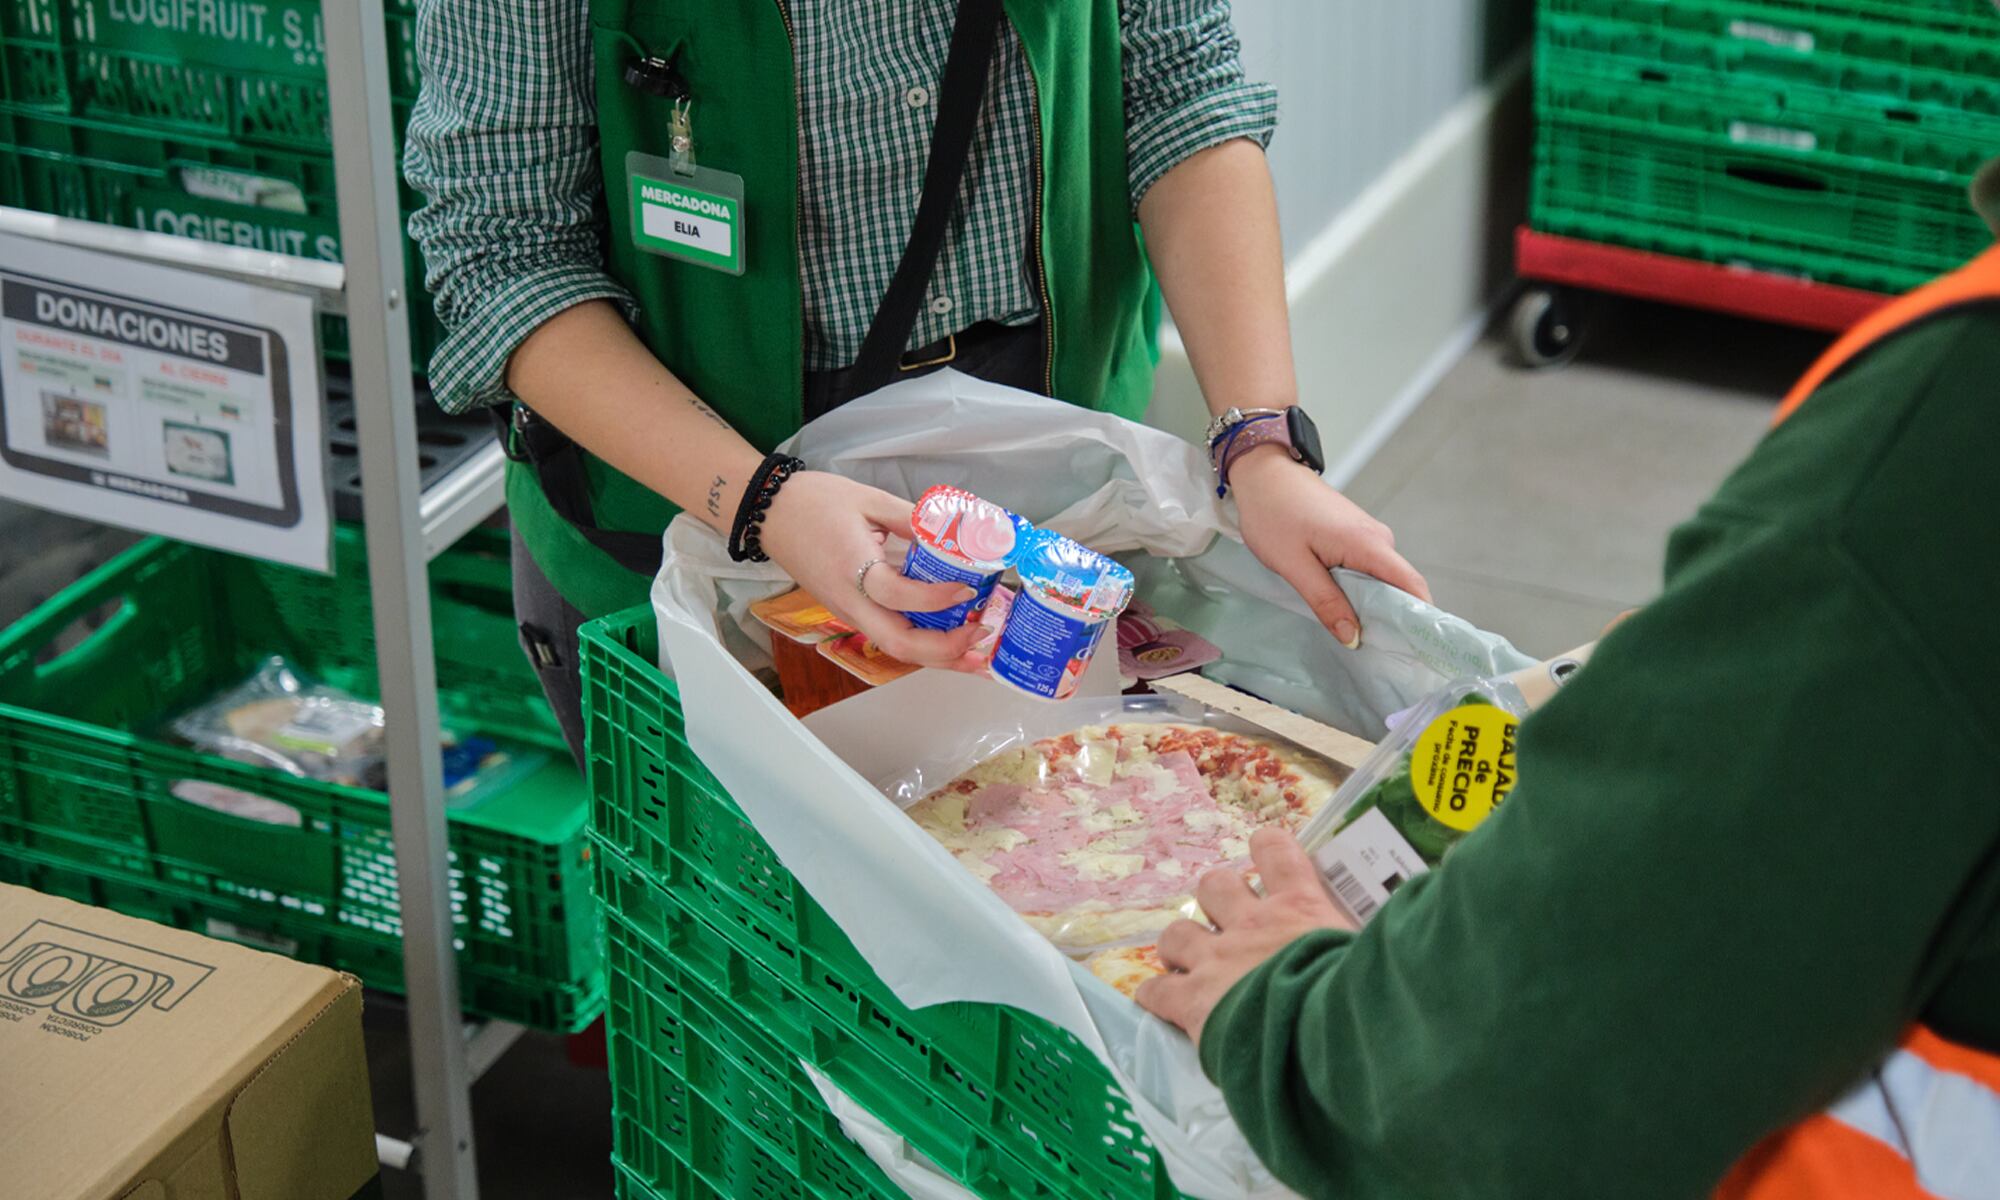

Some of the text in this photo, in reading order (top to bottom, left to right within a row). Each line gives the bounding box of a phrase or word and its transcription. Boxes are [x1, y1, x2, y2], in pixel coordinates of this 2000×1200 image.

[641, 185, 731, 220] MERCADONA
[674, 220, 701, 238] ELIA
[36, 291, 228, 361] DONACIONES
[1433, 720, 1458, 812] Fecha de consumo
[1449, 725, 1481, 811] PRECIO
[1475, 760, 1492, 783] de
[1490, 723, 1518, 811] BAJAD
